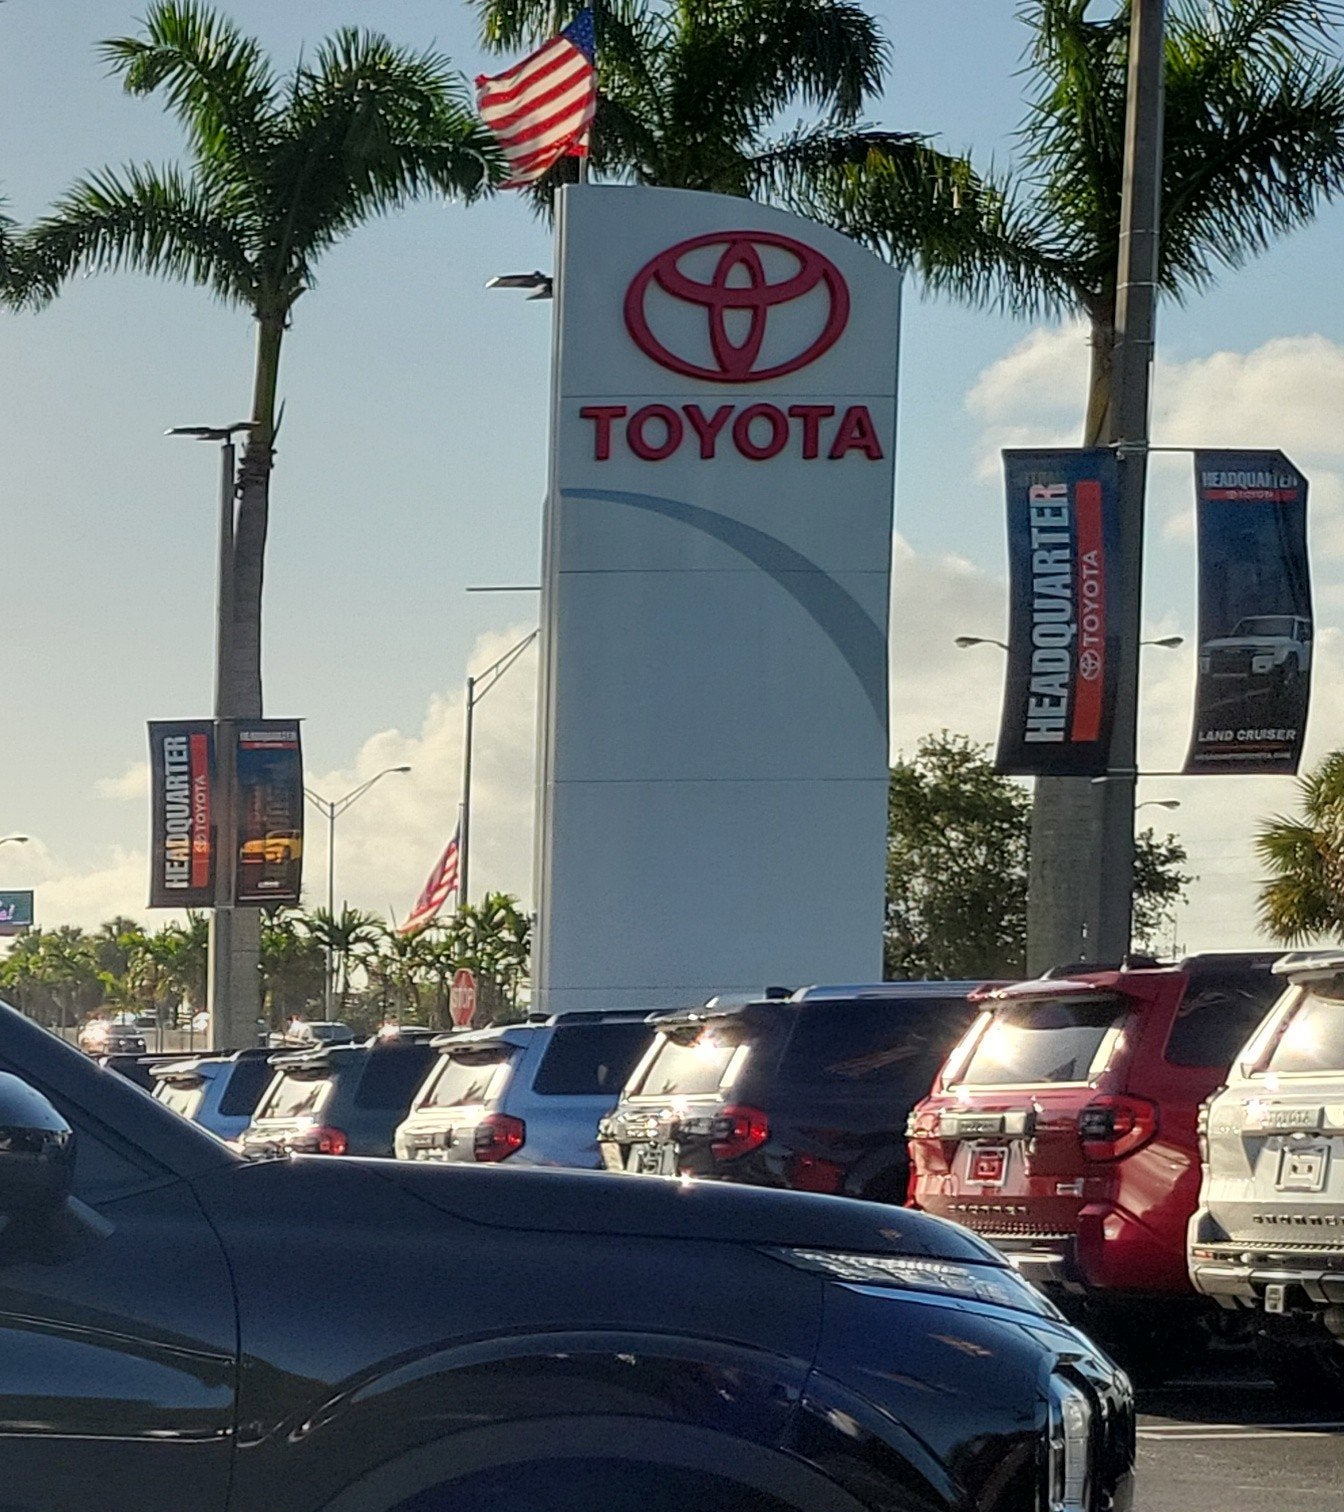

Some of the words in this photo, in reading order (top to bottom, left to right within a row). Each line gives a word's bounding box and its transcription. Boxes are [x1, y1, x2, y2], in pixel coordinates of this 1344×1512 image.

[579, 402, 884, 462] TOYOTA
[1024, 483, 1077, 742] HEADQUARTER
[1082, 550, 1100, 647] TOYOTA
[1197, 730, 1234, 741] LAND
[1236, 729, 1296, 740] CRUISER
[164, 736, 193, 888] HEADQUARTER
[194, 774, 208, 840] TOYOTA
